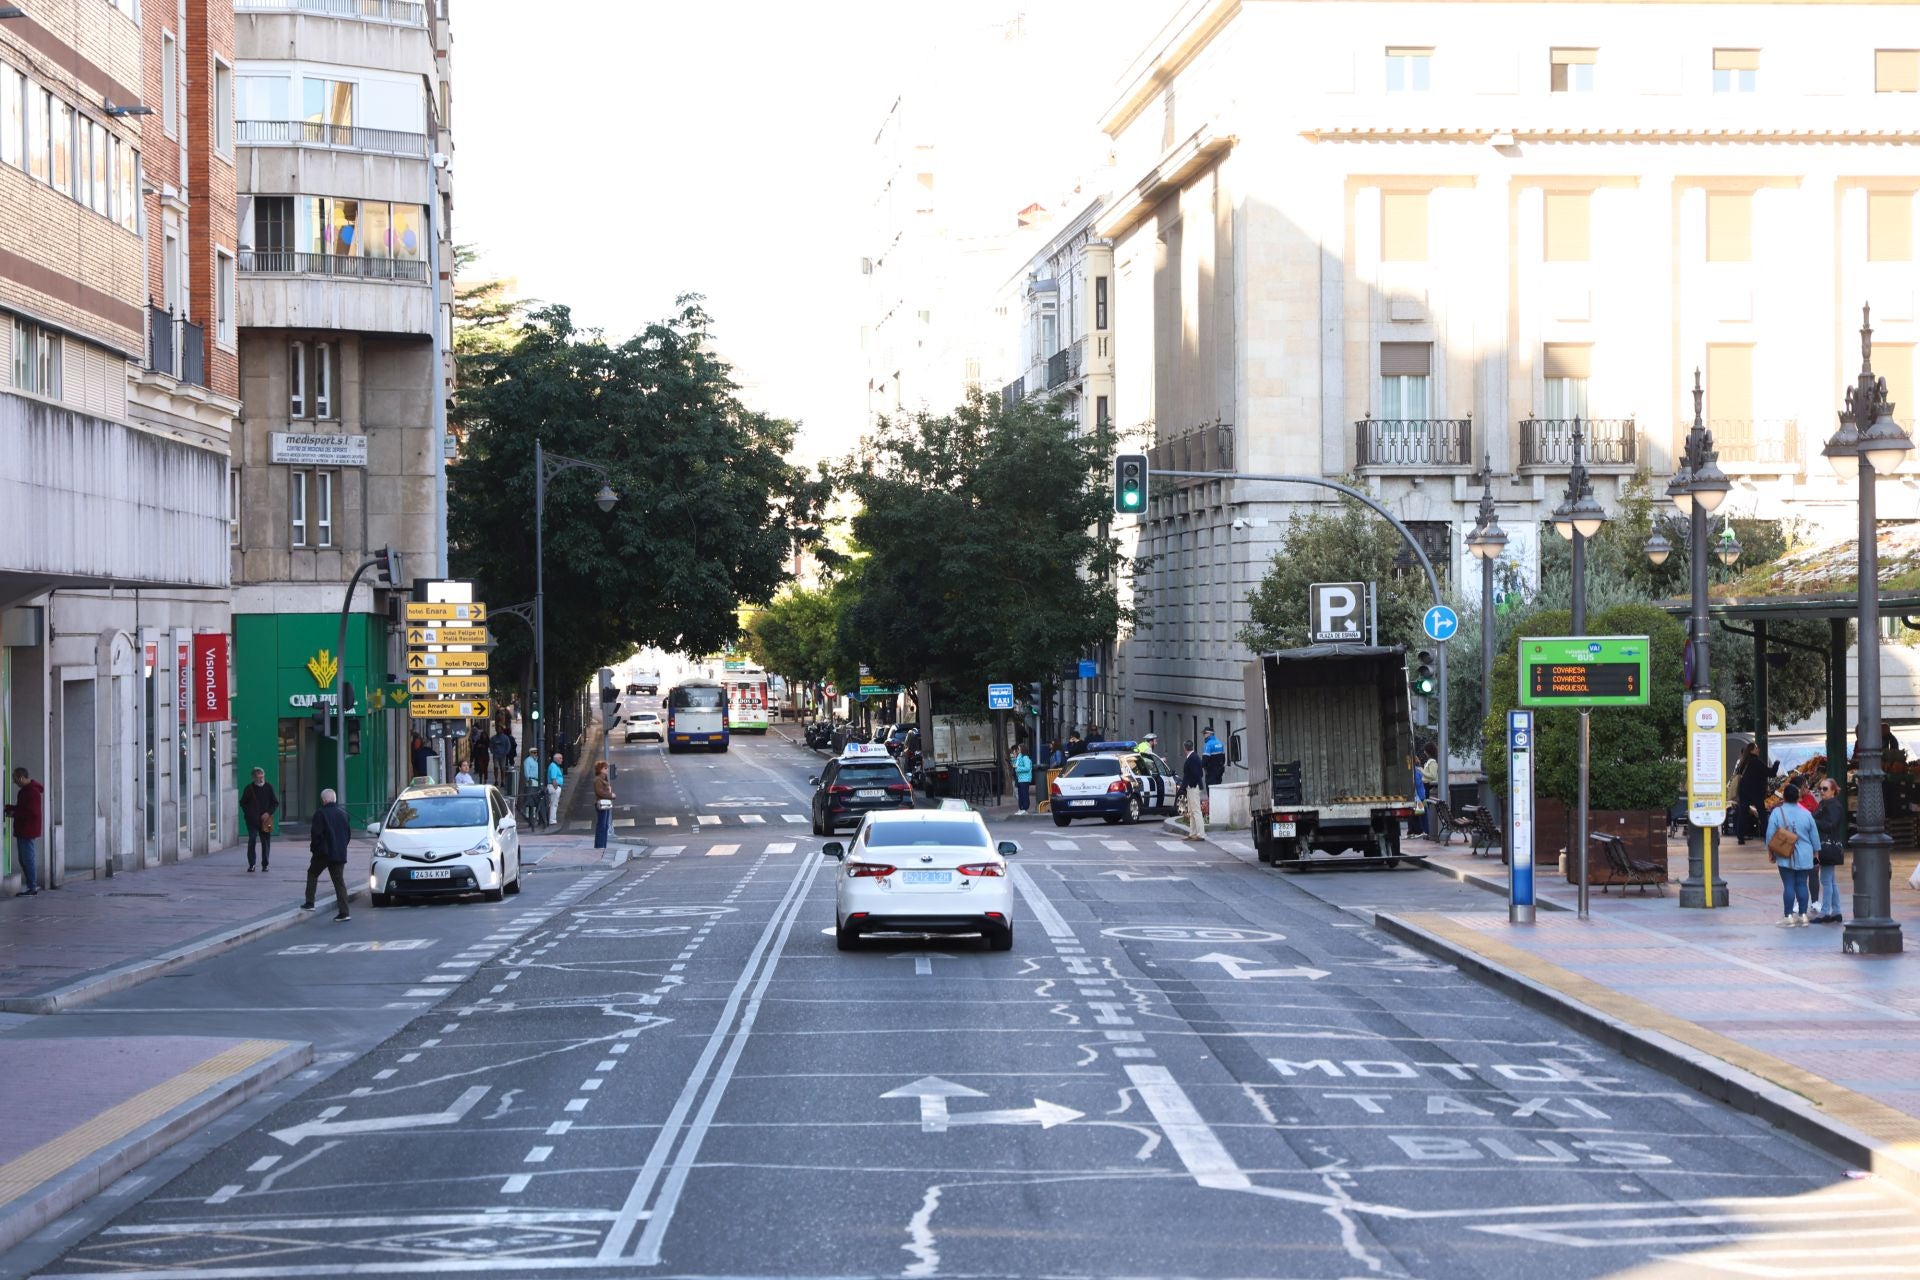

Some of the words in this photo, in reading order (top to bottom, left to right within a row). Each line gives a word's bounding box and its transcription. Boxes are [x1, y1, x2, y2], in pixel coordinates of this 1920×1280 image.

[1320, 587, 1356, 632] P
[289, 694, 317, 707] CAJA
[1142, 929, 1244, 939] 30
[277, 938, 441, 955] BUS
[1267, 1058, 1570, 1082] MOTO
[1323, 1093, 1611, 1119] TAXI
[1388, 1135, 1672, 1165] BUS
